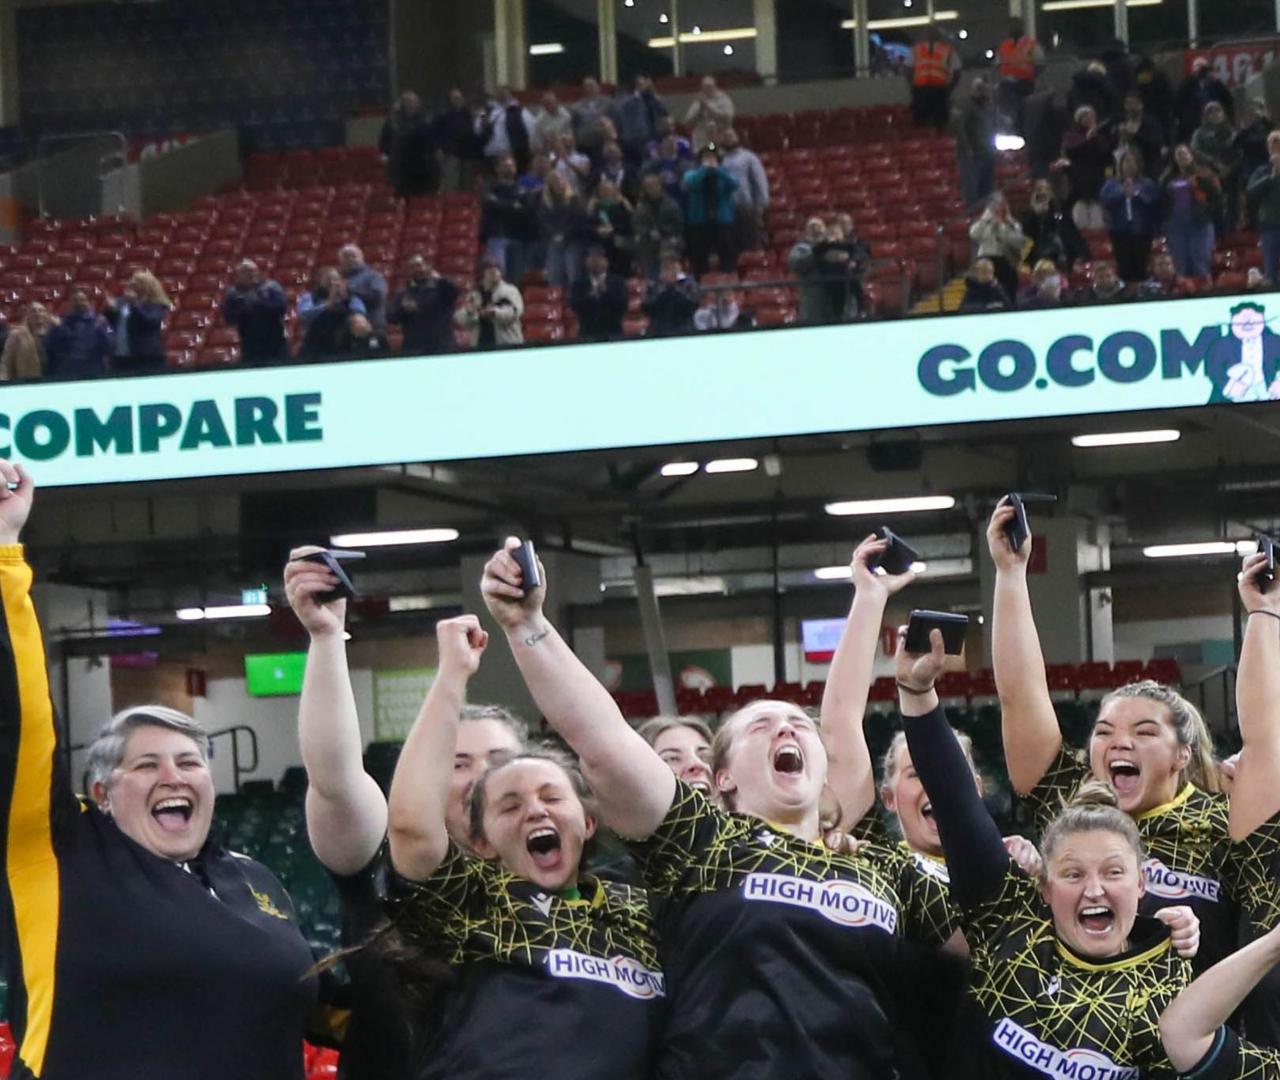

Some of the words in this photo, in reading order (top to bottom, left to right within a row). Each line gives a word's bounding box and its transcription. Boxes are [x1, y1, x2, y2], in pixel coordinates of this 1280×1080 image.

[749, 877, 813, 903] HIGH
[820, 889, 896, 930] MOTIVE
[554, 952, 610, 980] HIGH
[998, 1023, 1055, 1069] HIGH
